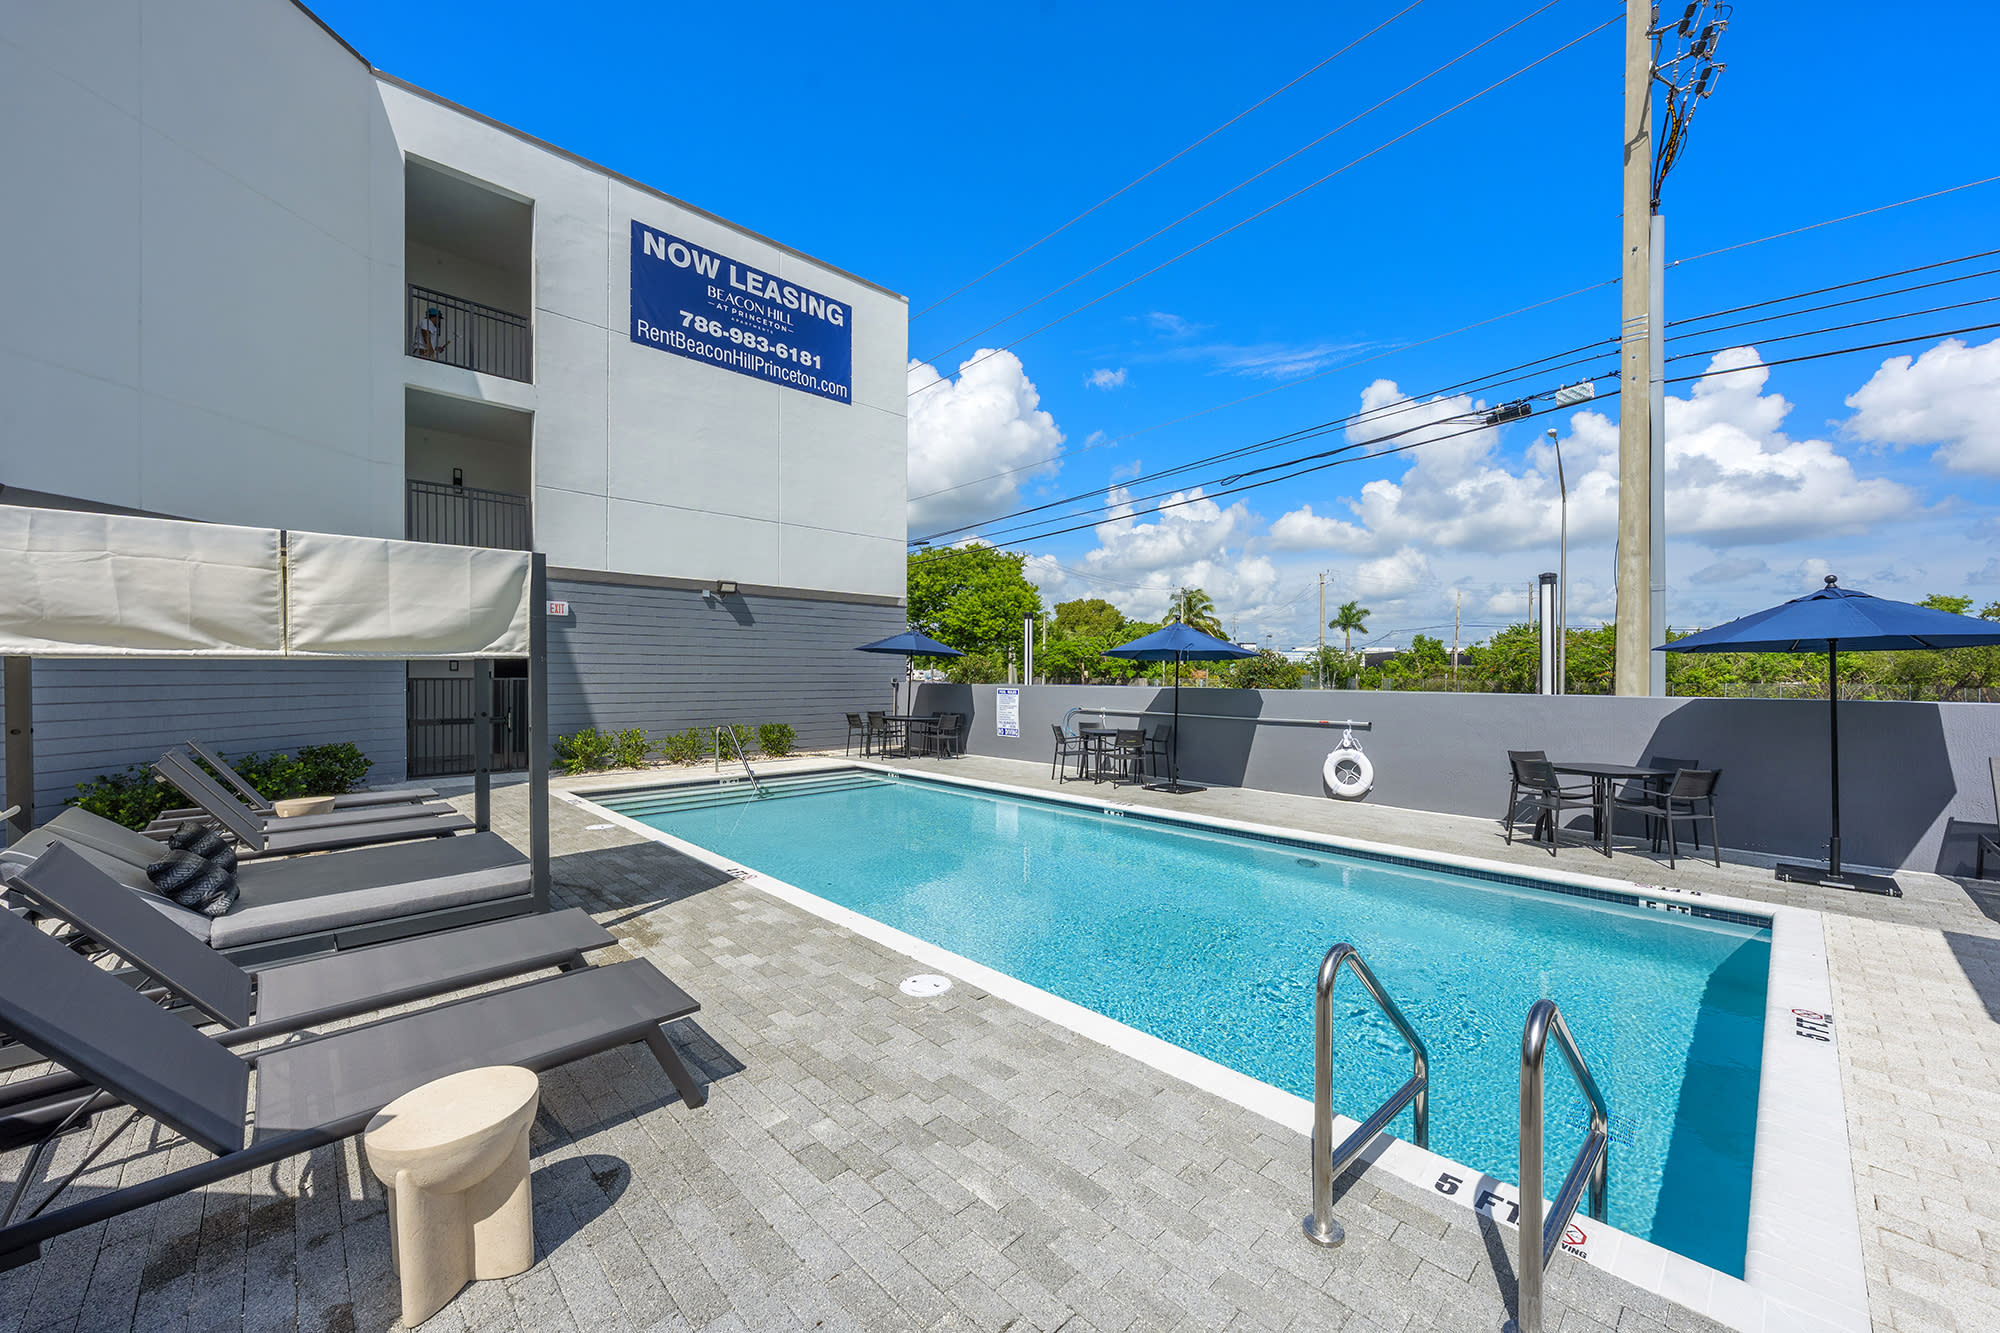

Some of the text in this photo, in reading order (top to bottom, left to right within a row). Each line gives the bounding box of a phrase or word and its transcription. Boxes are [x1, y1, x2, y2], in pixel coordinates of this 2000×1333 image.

[643, 230, 844, 327] NOW LEASING
[707, 285, 794, 326] BEACON HILL
[716, 303, 787, 333] AT PRINCETON
[680, 310, 821, 370] 786-983-6181
[637, 318, 848, 398] RentBeaconHillPrinceton.com
[550, 603, 565, 614] EXIT
[1796, 1030, 1830, 1042] 5
[1434, 1172, 1463, 1196] 5
